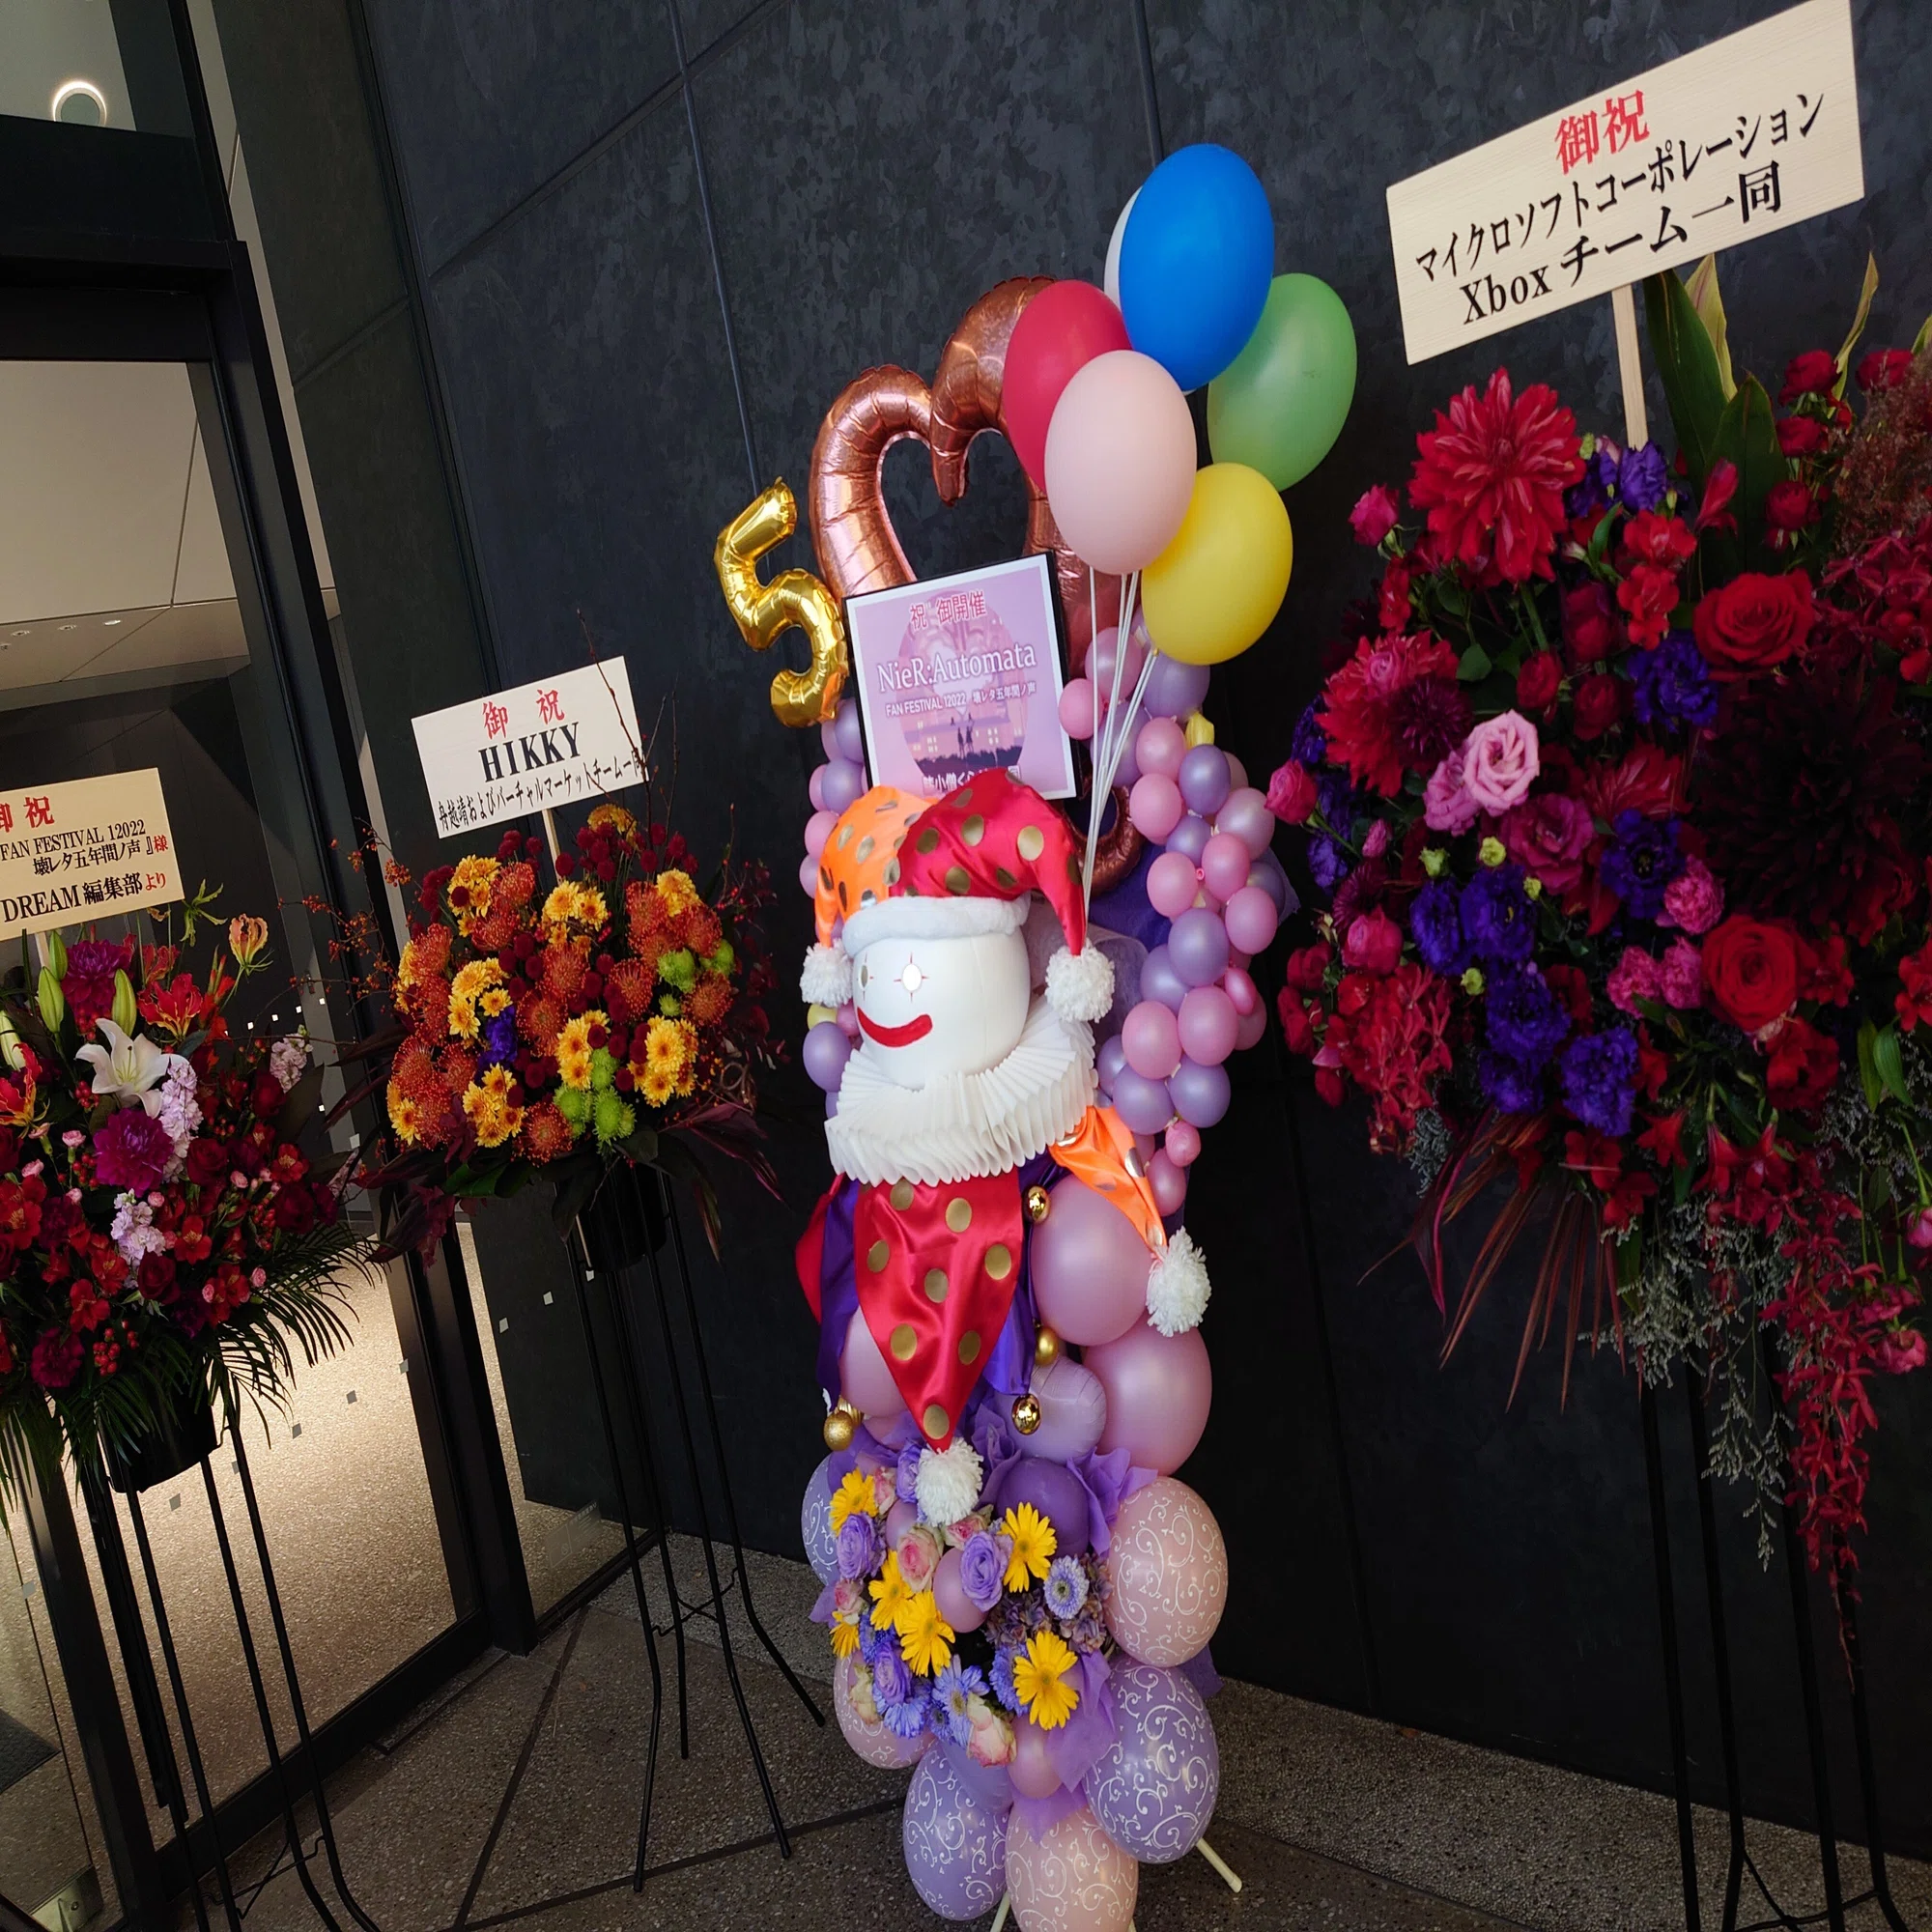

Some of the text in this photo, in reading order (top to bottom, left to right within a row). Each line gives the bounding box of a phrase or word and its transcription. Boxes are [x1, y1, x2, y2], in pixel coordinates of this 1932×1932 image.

[1554, 89, 1651, 175] 御祝
[1415, 93, 1825, 282] マイクロソフトコーポレーション
[1460, 160, 1781, 326] Xbox チーム一同
[714, 476, 849, 728] 5
[909, 590, 987, 630] 祝 御開催
[876, 642, 1037, 693] NieR:Automata
[885, 701, 904, 717] FAN
[904, 696, 943, 714] FESTIVAL
[944, 693, 967, 709] 12022
[478, 722, 581, 782] HIKKY
[0, 819, 146, 861] FAN FESTIVAL 12022
[0, 884, 82, 923] DREAM
